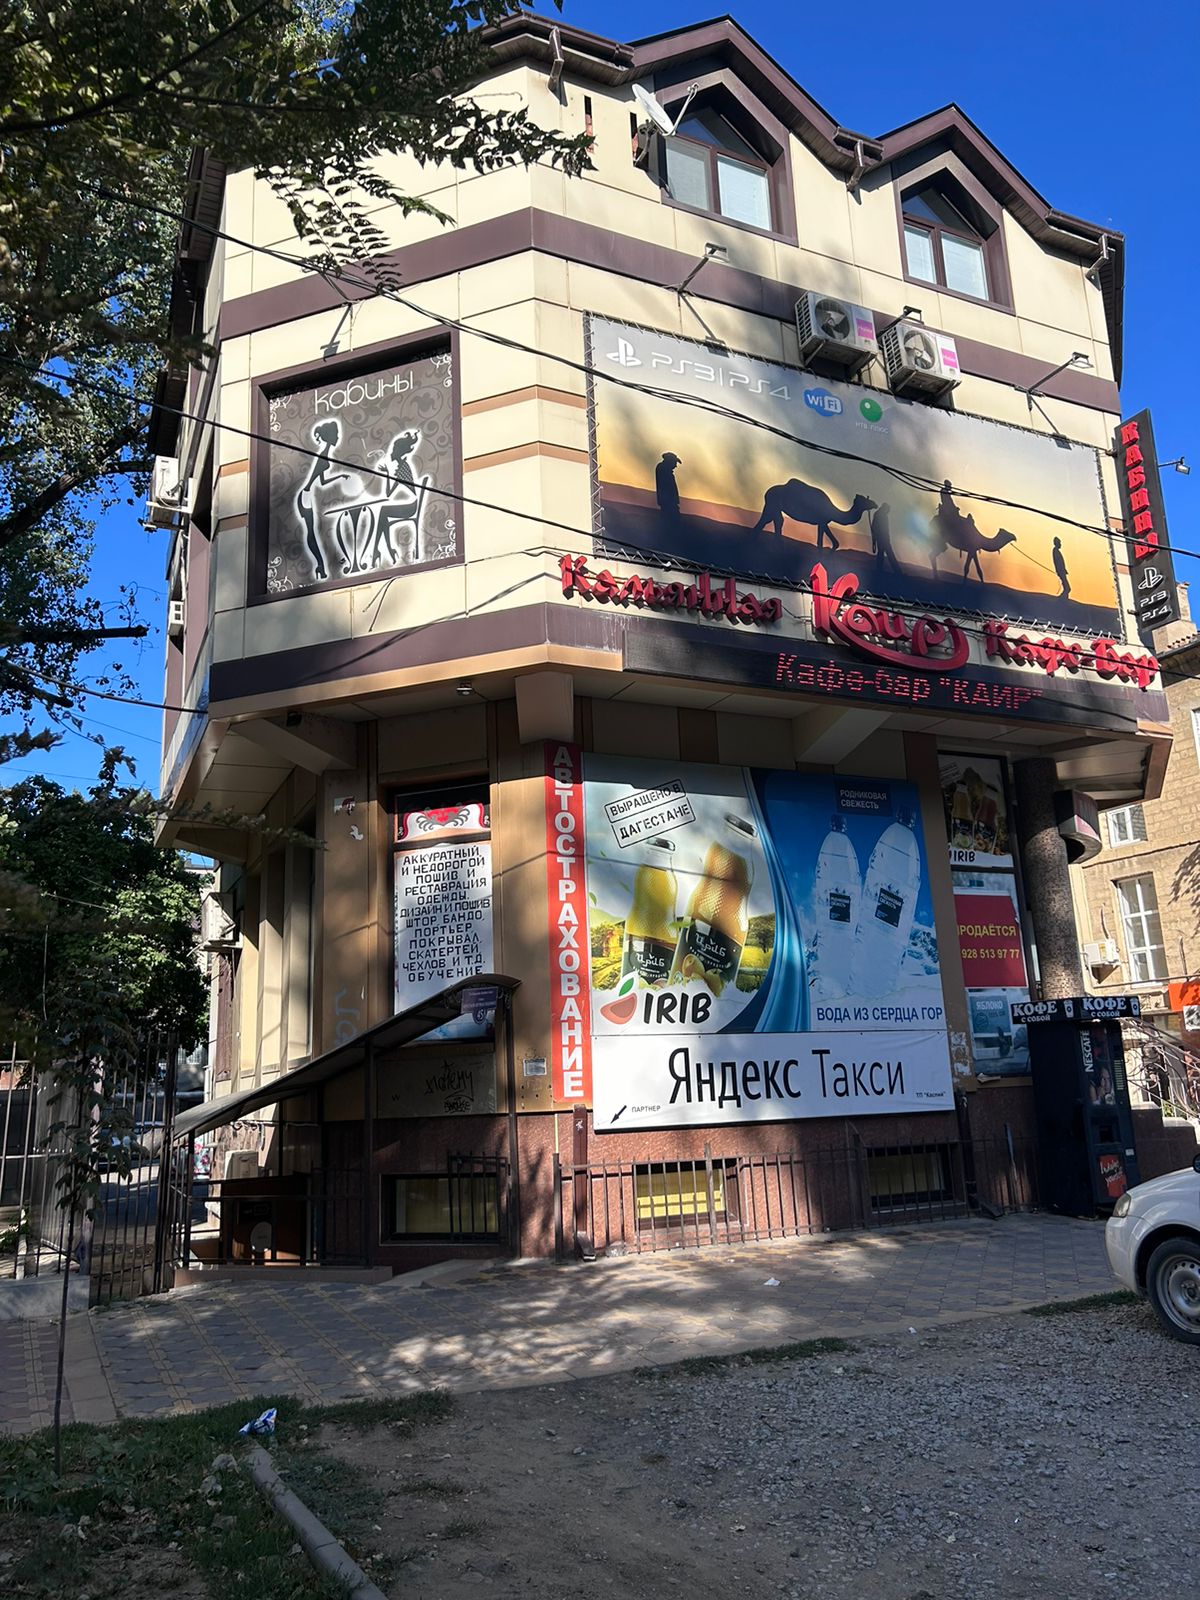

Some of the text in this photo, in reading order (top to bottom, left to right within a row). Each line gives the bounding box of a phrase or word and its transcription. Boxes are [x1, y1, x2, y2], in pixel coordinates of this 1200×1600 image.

[1121, 420, 1159, 560] КАБИНЫ
[1139, 591, 1167, 607] PS3
[1141, 607, 1169, 622] PS4
[610, 783, 681, 816] ВЫРАЩЕНО В
[840, 789, 887, 800] РОДНИКОВАЯ
[841, 799, 879, 809] СВЕЖЕСТЬ
[620, 804, 690, 839] ДАГЕСТАНЕ
[401, 855, 485, 876] И НЕДОРОГОЙ
[416, 868, 475, 884] ПОШИВ И
[405, 877, 487, 896] РЕСТАВРАЦИЯ
[417, 891, 470, 905] ОДЕЖДЫ.
[400, 899, 491, 918] ДИЗАЙН И ПОШИВ
[553, 746, 585, 1098] АВТОСТРАХОВАНИЕ
[962, 948, 1020, 959] 928 513 97 77
[402, 958, 446, 972] ЧЕХЛОВ
[452, 956, 460, 966] И
[408, 966, 483, 982] ОБУЧЕНИЕ
[644, 992, 712, 1024] IRIB
[1013, 1001, 1058, 1017] КОФЕ
[1083, 997, 1127, 1011] КОФЕ
[817, 1007, 943, 1023] ВОДА ИЗ СЕРДЦА ГОР
[668, 1047, 905, 1108] Яндекс Такси
[631, 1104, 661, 1114] ПАРТНЕР
